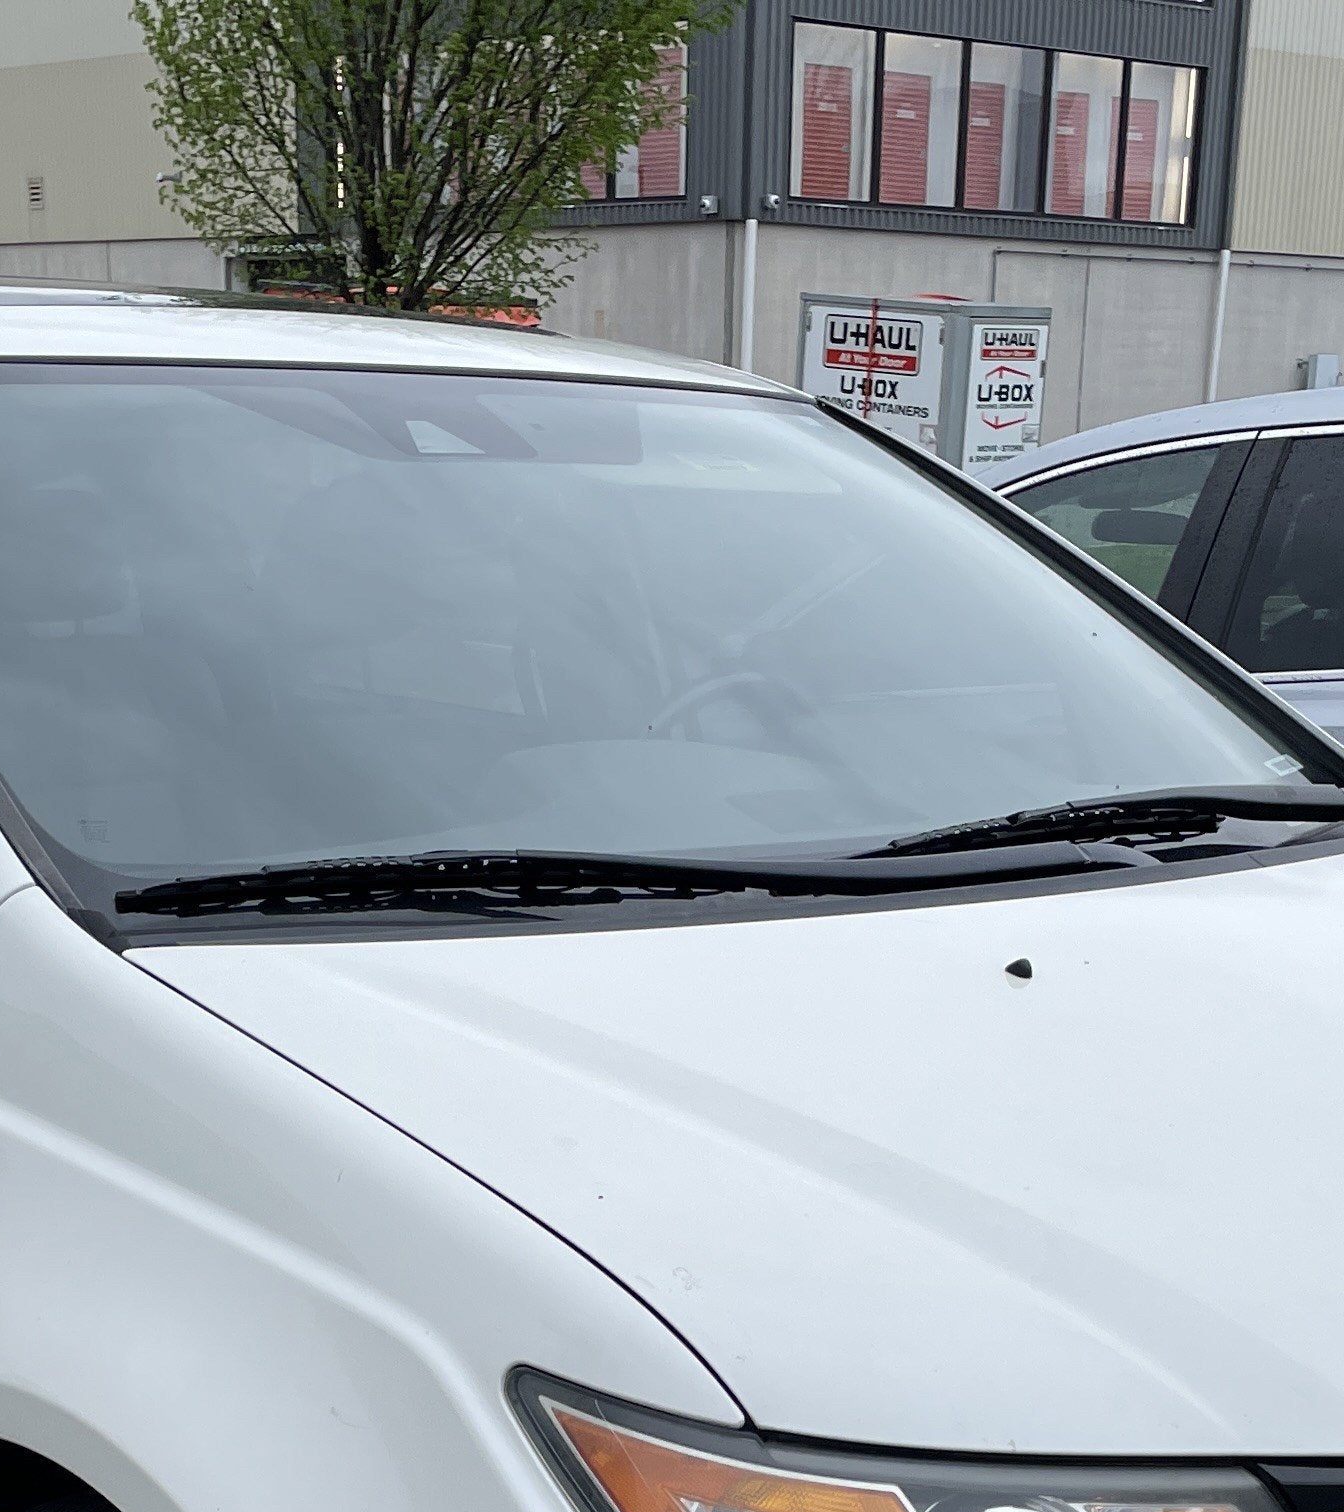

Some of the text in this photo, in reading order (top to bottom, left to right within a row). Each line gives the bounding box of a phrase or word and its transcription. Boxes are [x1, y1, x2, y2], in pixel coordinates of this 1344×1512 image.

[830, 321, 917, 351] U-HAUL
[984, 332, 1036, 346] U-HAUL
[977, 384, 1035, 402] U-BOX
[856, 400, 929, 418] CONTAINERS
